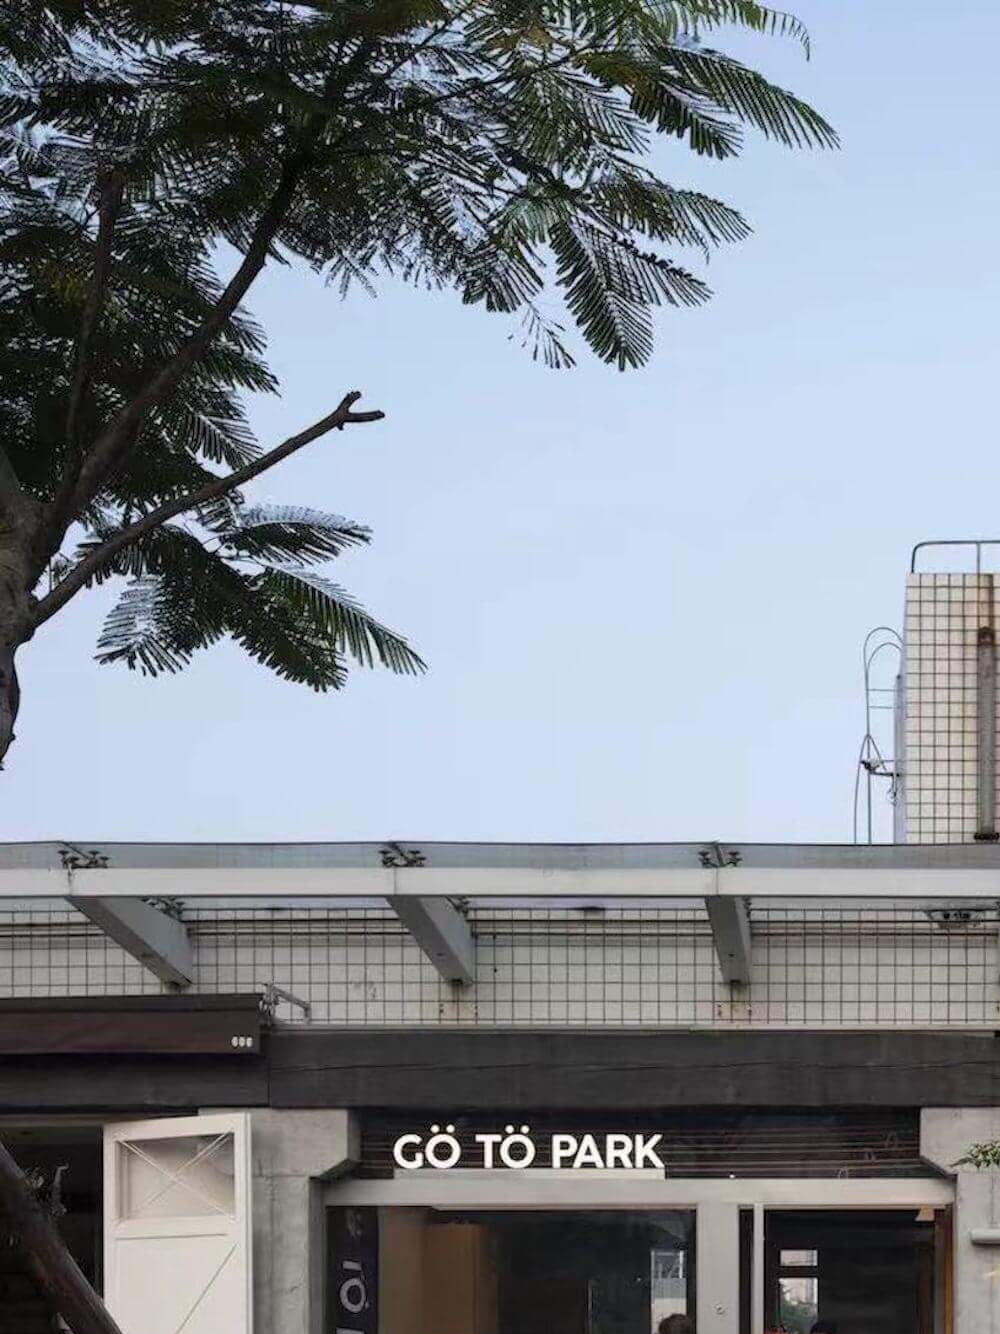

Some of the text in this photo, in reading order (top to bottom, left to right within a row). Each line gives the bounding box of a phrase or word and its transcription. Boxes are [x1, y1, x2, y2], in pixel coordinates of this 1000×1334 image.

[393, 1124, 665, 1169] GÖ TÖ PARK
